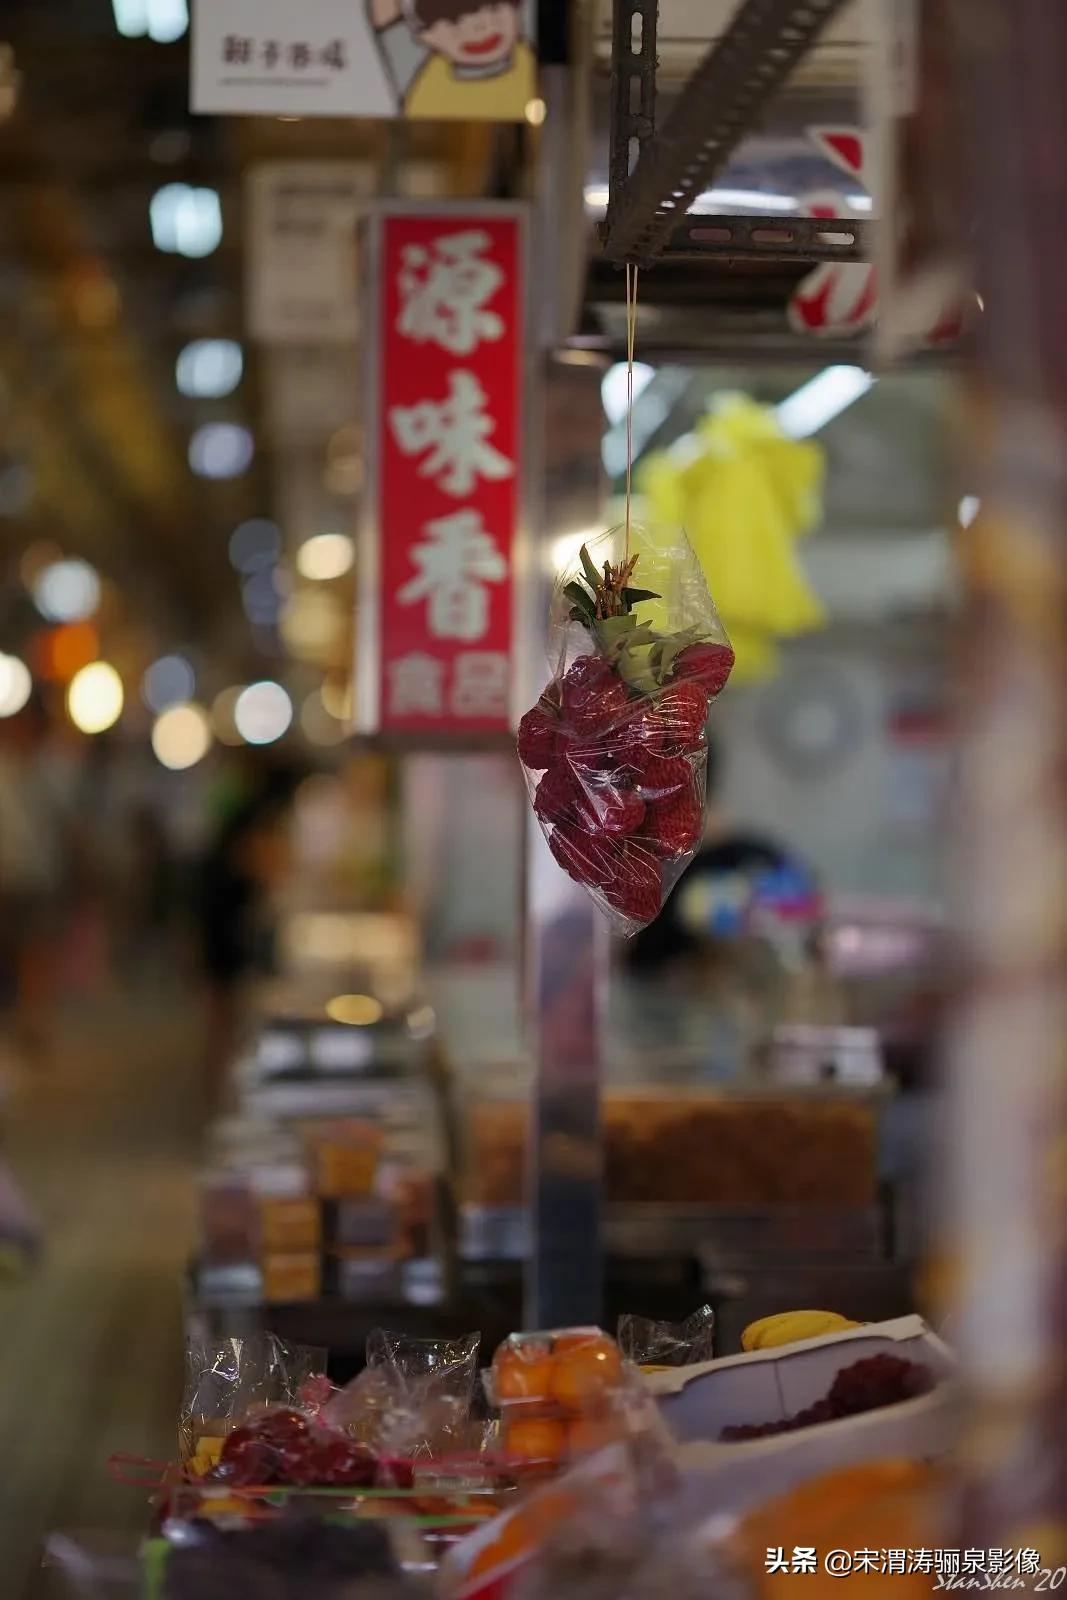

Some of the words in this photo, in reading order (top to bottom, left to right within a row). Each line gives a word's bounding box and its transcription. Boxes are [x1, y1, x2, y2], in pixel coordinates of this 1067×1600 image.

[389, 231, 512, 641] 源味香
[389, 650, 509, 715] 食品
